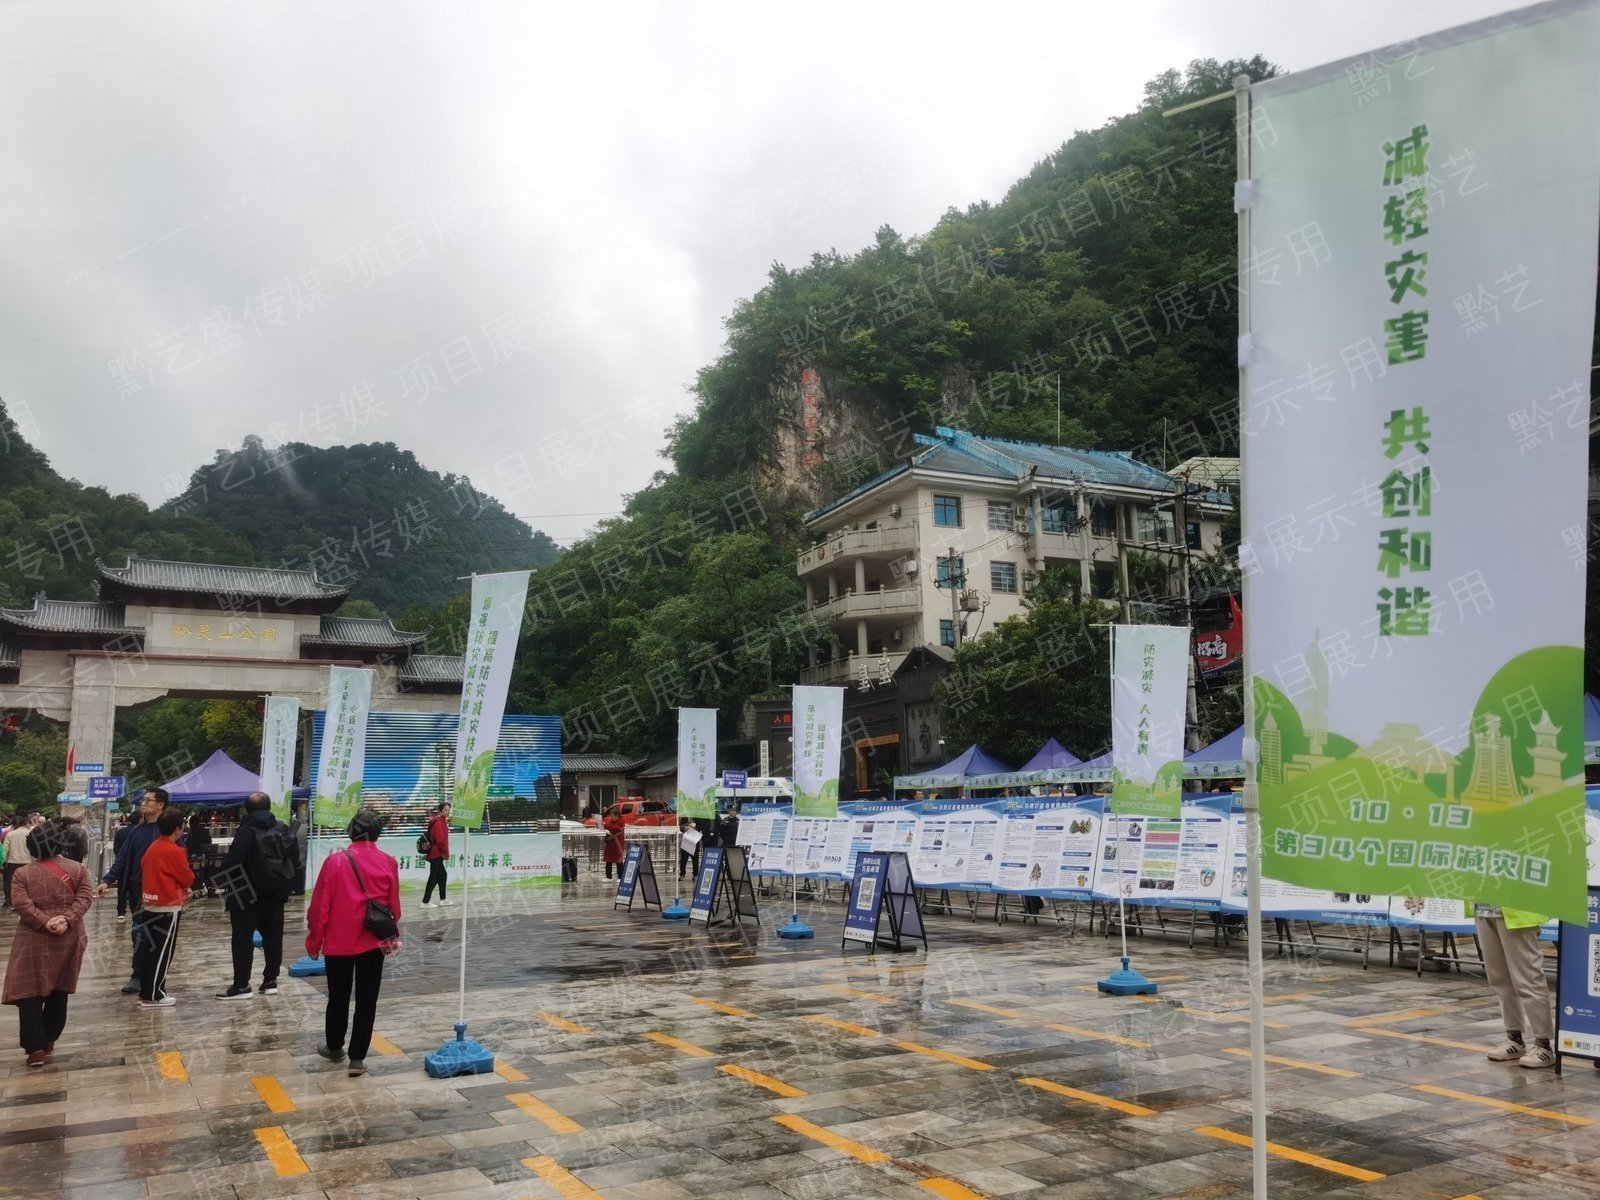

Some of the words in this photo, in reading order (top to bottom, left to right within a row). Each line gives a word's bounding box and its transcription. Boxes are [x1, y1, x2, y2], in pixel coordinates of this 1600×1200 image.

[1381, 124, 1430, 366] 减轻灾害
[1376, 406, 1432, 637] 共创和谐
[1141, 643, 1156, 694] 防灾减灾
[1137, 703, 1150, 756] 人人有责
[400, 853, 513, 869] 打造韧性的未来
[1274, 828, 1551, 887] 第34个国际减灾日
